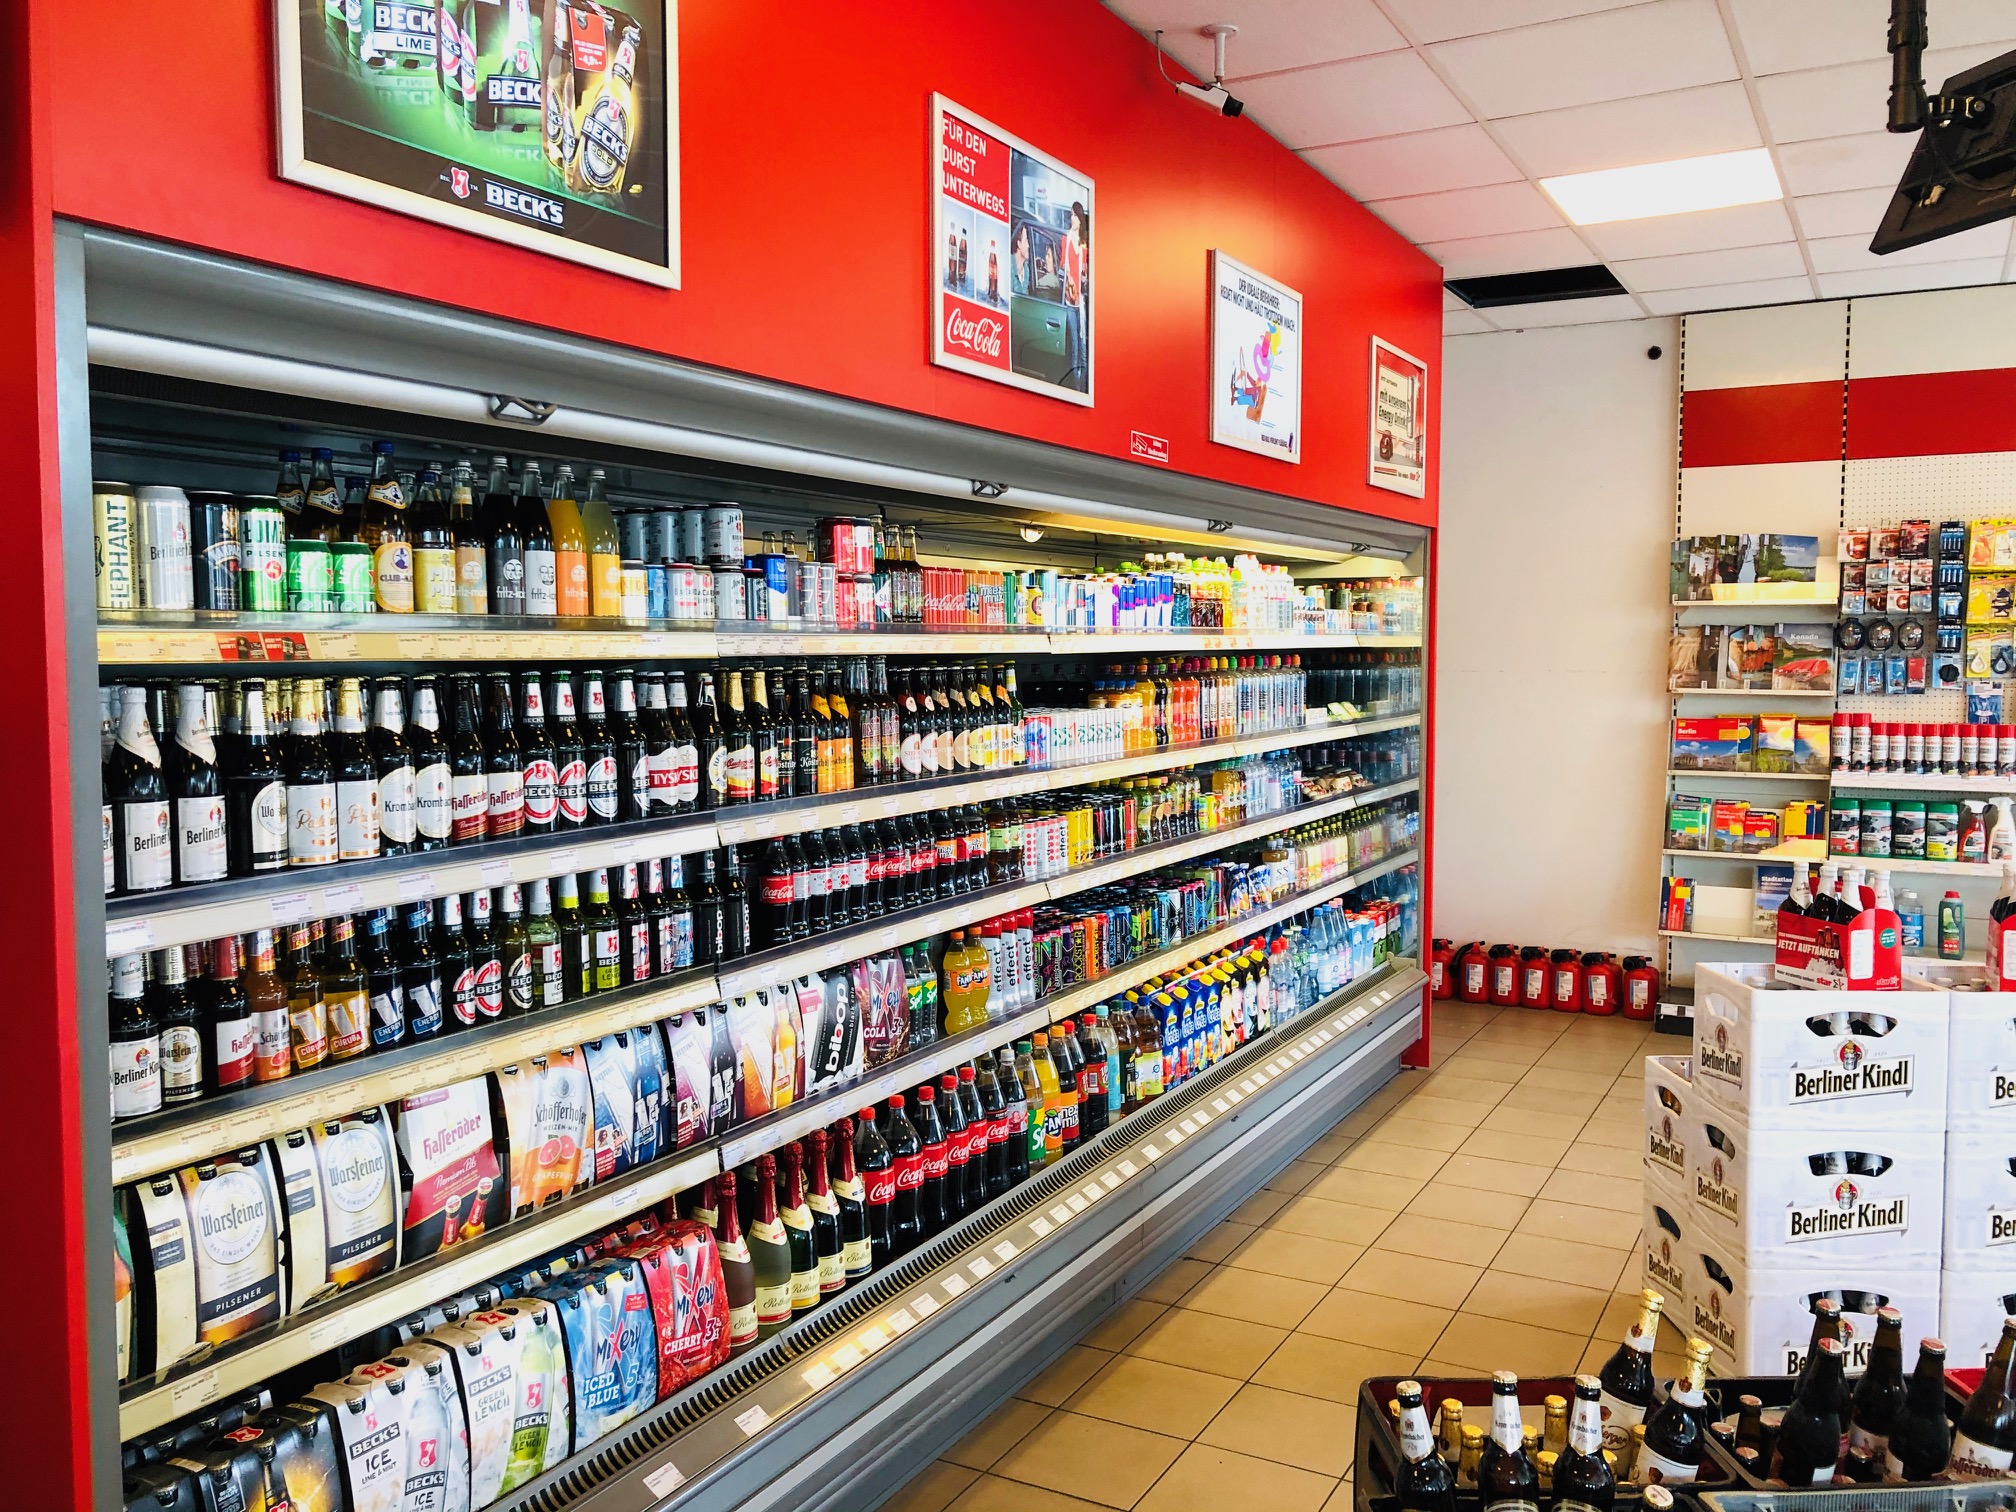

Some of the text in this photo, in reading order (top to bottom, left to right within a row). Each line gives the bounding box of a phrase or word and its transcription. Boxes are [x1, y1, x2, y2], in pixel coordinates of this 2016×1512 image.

[396, 36, 431, 50] LIME
[943, 117, 986, 157] FÜR DEN
[943, 147, 976, 177] DURST
[486, 182, 563, 224] BECK'S
[943, 170, 1008, 218] UNTERWEGS.
[947, 307, 1003, 358] Coca-Cola
[106, 500, 131, 609] ELEPHANT
[134, 832, 167, 851] Berliner
[186, 826, 220, 845] Berliner
[1023, 940, 1031, 981] effect
[1777, 939, 1840, 960] JETZT AUFTANKEN
[993, 950, 1001, 992] effect
[1006, 944, 1016, 986] effect
[1816, 977, 1832, 987] star
[333, 1030, 362, 1048] CURUBA
[825, 982, 848, 1072] bibop
[864, 1025, 886, 1038] COLA
[1701, 1043, 1742, 1079] Berliner Kindl
[114, 1065, 148, 1086] Berliner
[1795, 1060, 1909, 1098] Berliner Kindl
[535, 1101, 587, 1127] Schöfferhofer
[1650, 1134, 1668, 1158] Berliner
[329, 1155, 384, 1186] Warsteiner
[1697, 1176, 1738, 1215] Berliner Kindl
[200, 1199, 264, 1238] Warsteiner
[1791, 1200, 1904, 1237] Berliner Kindl
[342, 1234, 382, 1255] PILSENER
[1649, 1252, 1668, 1278] Berliner
[216, 1286, 262, 1312] PILSENER
[1695, 1305, 1719, 1335] Berliner
[664, 1333, 702, 1355] CHERRY
[470, 1366, 511, 1394] BECK'S
[585, 1372, 615, 1393] ICED
[478, 1387, 505, 1408] GREEN
[588, 1385, 620, 1408] BLUE
[474, 1398, 510, 1422] LEMON
[515, 1414, 548, 1430] BECK'S
[351, 1423, 399, 1458] BECK'S
[366, 1449, 392, 1473] ICE
[361, 1474, 376, 1485] LIME
[406, 1472, 445, 1491] BECK'S
[414, 1491, 433, 1504] ICE
